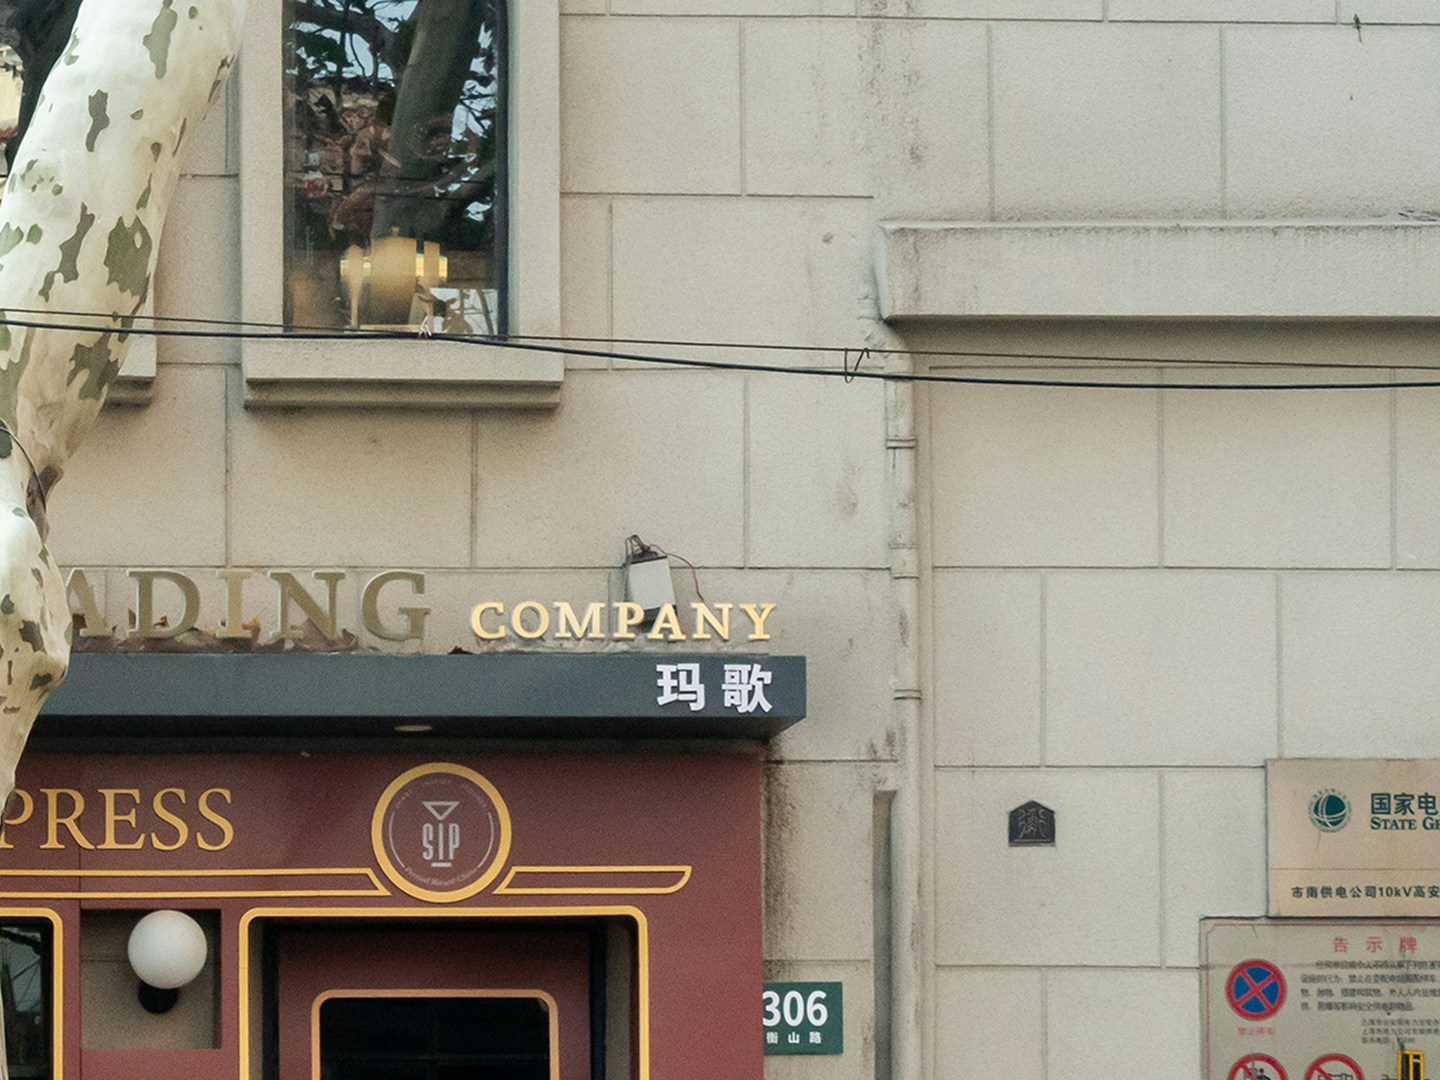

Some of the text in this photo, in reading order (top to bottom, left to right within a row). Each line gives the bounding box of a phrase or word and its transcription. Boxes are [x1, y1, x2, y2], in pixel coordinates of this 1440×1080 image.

[470, 600, 777, 641] COMPANY
[656, 662, 774, 714] 玛歌
[422, 823, 460, 861] SIP
[1370, 816, 1417, 830] STATE
[762, 989, 829, 1027] 306
